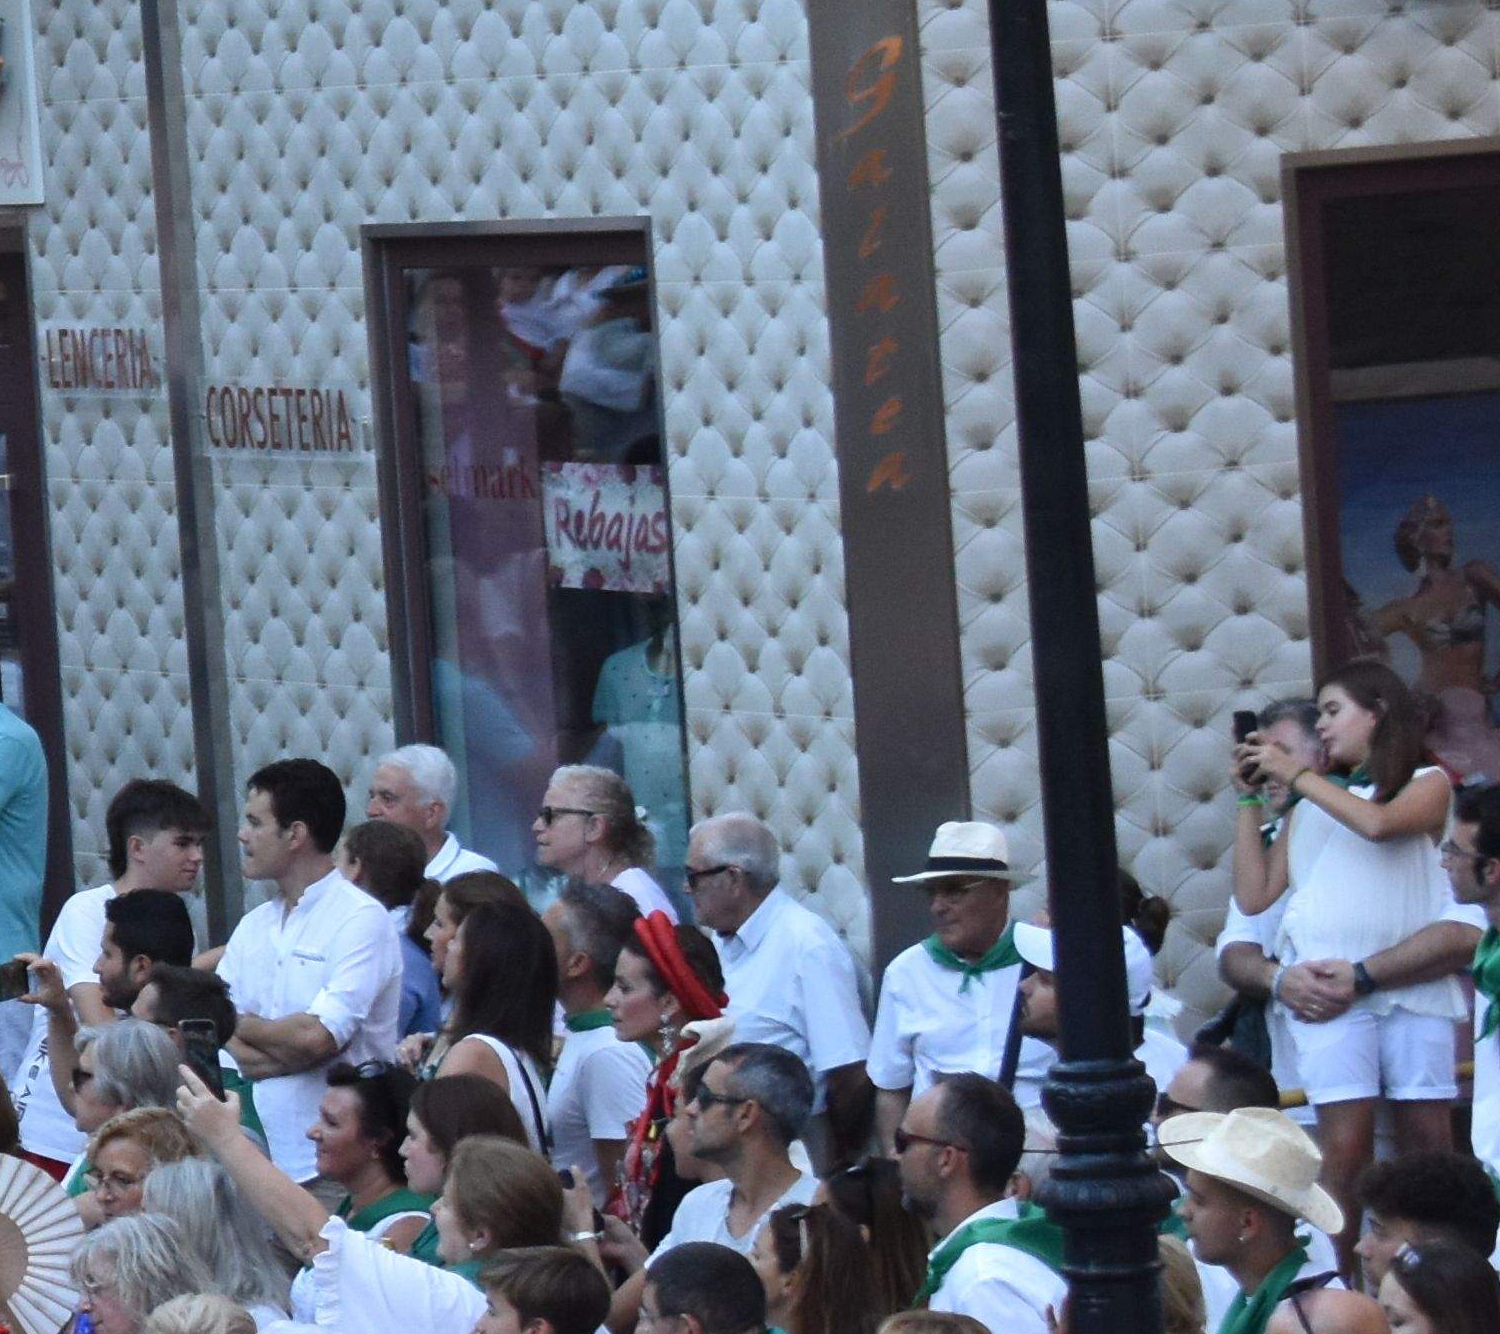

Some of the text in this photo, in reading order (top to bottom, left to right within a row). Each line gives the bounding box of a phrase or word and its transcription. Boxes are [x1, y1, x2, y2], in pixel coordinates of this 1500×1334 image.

[46, 327, 160, 389] LENCERIA
[206, 385, 354, 452] CORSETERIA
[553, 493, 670, 573] Rebajas
